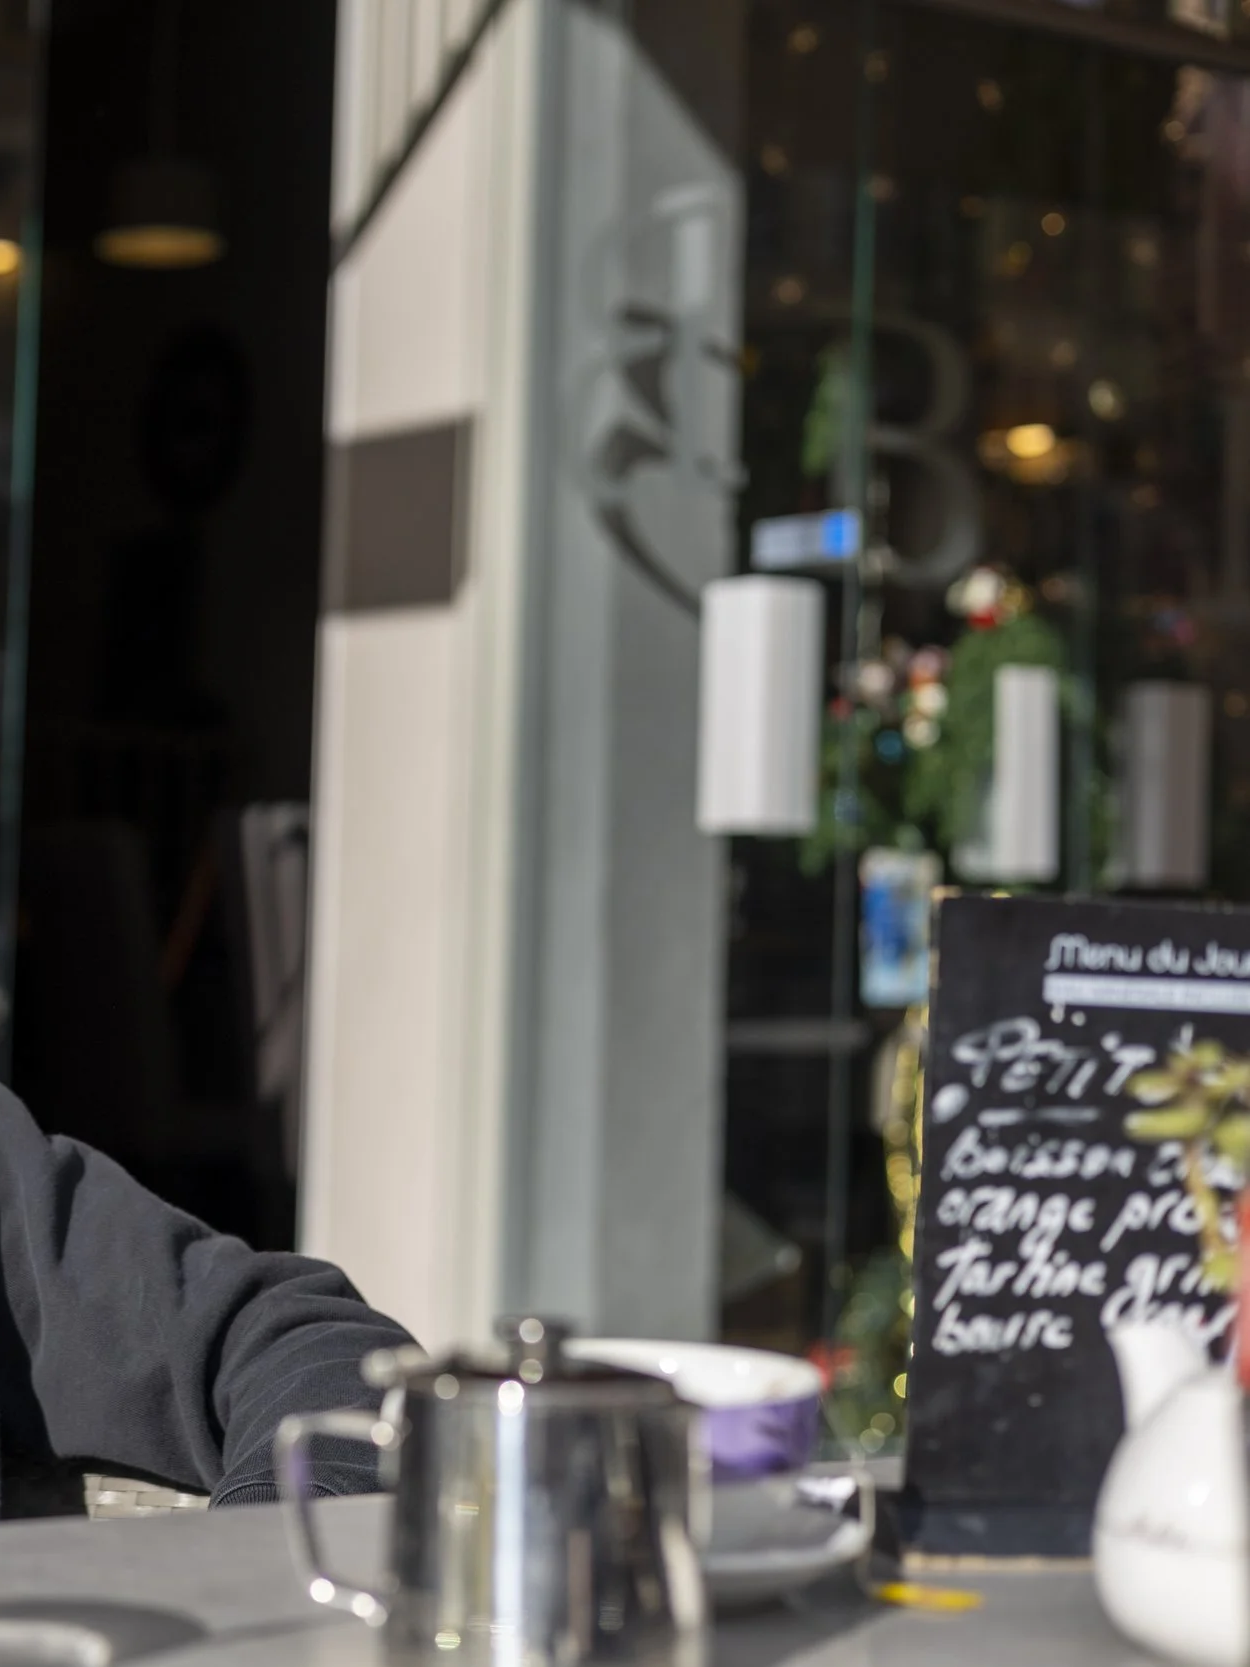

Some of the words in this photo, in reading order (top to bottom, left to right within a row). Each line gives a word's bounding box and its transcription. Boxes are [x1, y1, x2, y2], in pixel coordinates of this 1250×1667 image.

[1044, 933, 1142, 972] Menu
[1147, 938, 1190, 974] du
[1193, 940, 1250, 979] Jou
[936, 1187, 1096, 1259] orange
